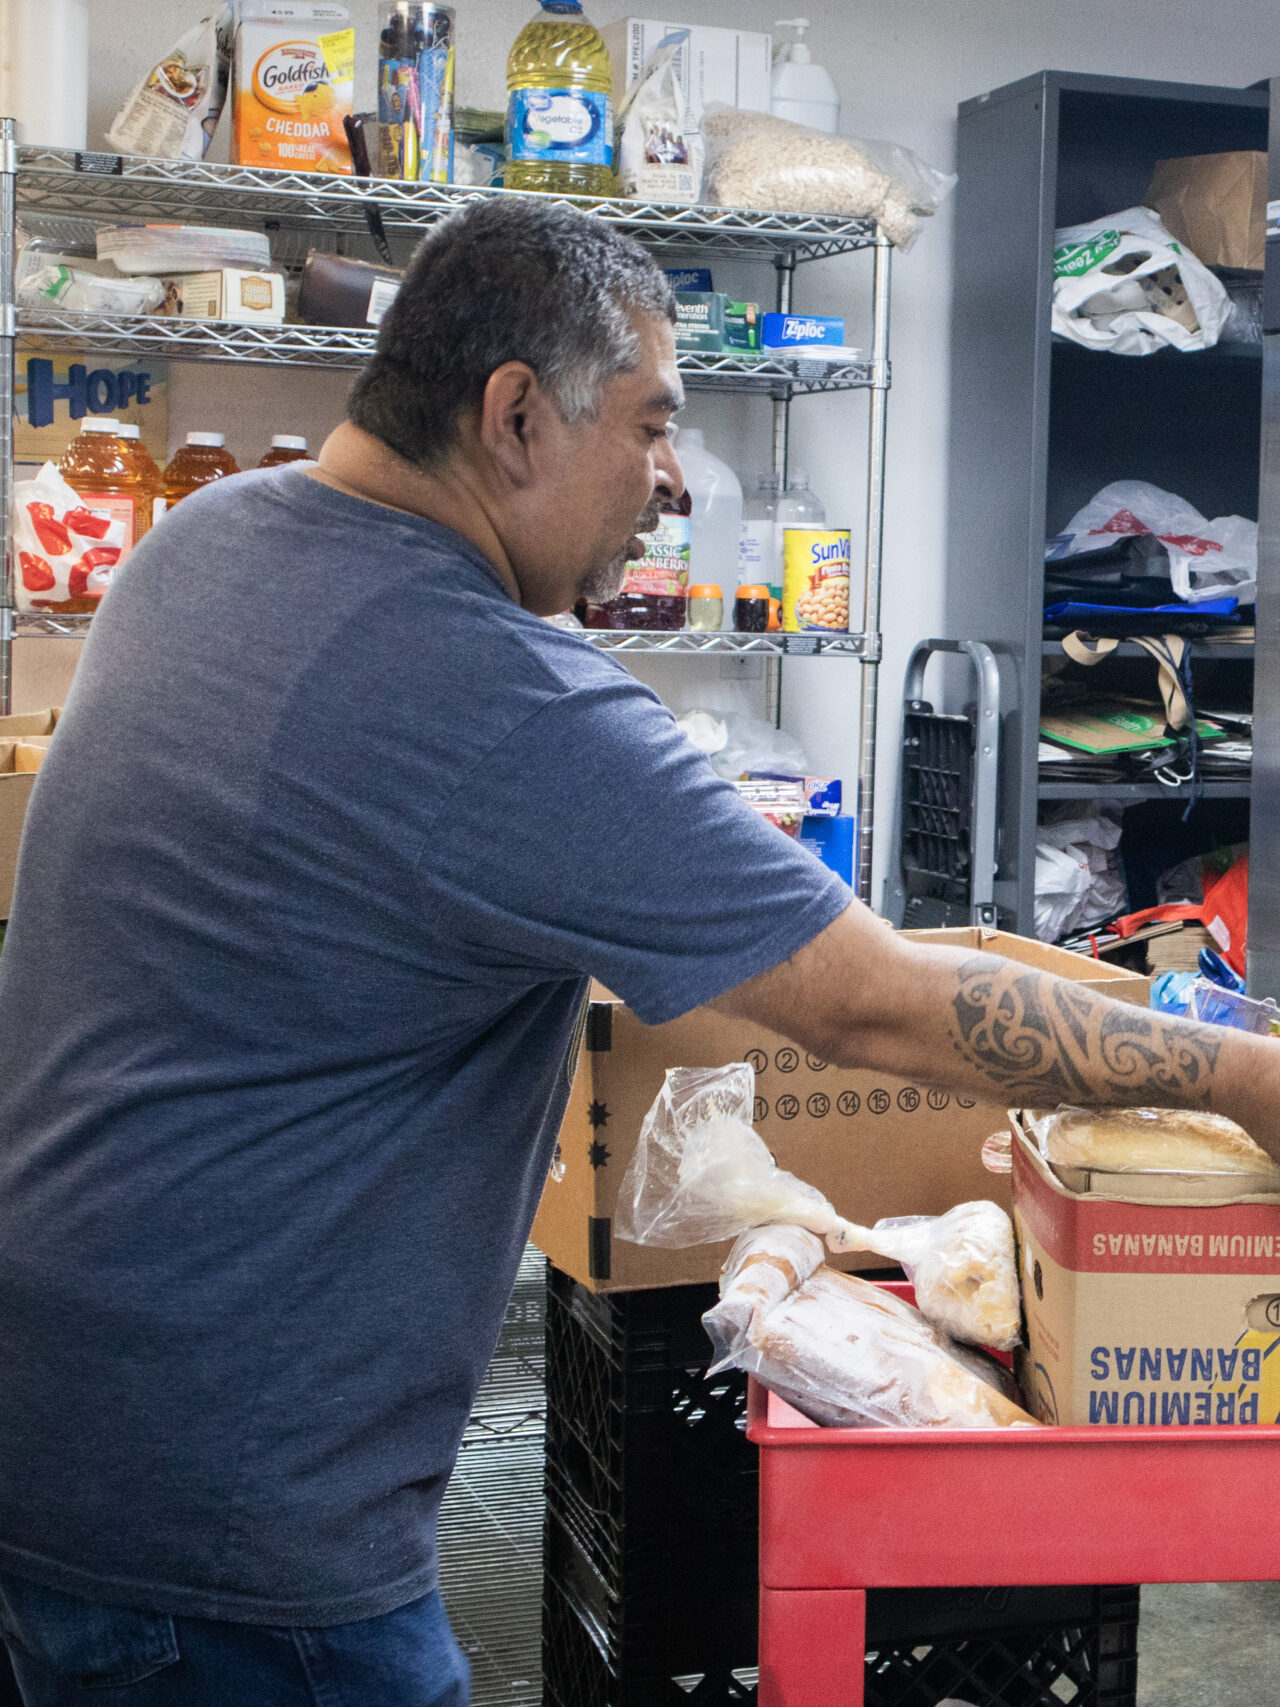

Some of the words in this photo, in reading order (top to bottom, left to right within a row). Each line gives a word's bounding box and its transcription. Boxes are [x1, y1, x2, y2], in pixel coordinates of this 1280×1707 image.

[263, 61, 329, 88] Goldfish
[266, 117, 330, 138] CHEDDAR
[667, 271, 699, 287] iploc
[675, 303, 708, 314] eventh
[786, 320, 825, 340] Ziploc
[26, 357, 152, 428] HOPE
[644, 543, 682, 558] ASSIC
[1093, 1233, 1204, 1257] BANANAS
[1089, 1346, 1261, 1382] BANANAS
[1089, 1390, 1260, 1425] PREMIUM
